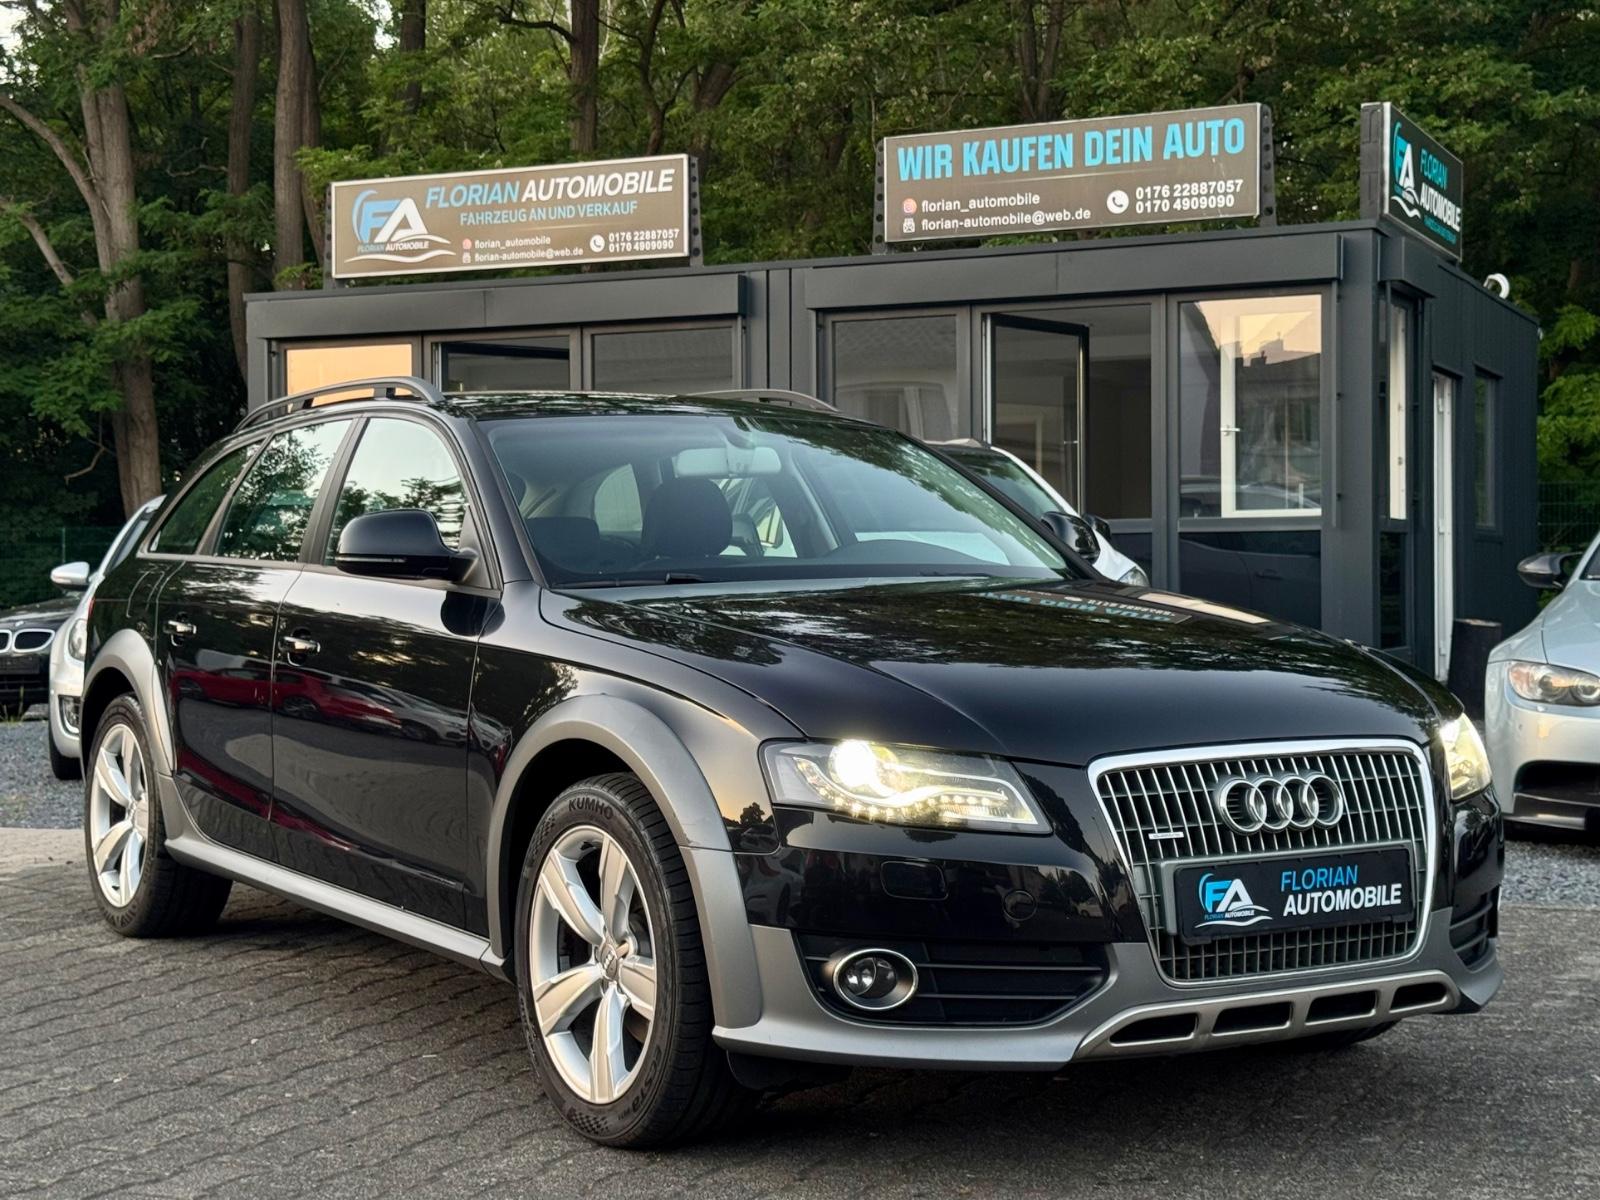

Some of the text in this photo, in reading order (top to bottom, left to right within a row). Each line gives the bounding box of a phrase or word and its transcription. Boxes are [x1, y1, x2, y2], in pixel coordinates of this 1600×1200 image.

[897, 117, 1245, 181] WIR KAUFEN DEIN AUTO
[1420, 147, 1448, 191] FLORIAN
[425, 168, 675, 209] FLORIAN AUTOMOBILE
[1135, 179, 1244, 200] 0176 22887057
[460, 200, 638, 226] FAHRZEUG AN UND VERKAUF
[921, 192, 1041, 213] florian_automobile
[1135, 194, 1235, 214] 0170 4909090
[1420, 182, 1461, 233] AUTOMOBILE
[360, 198, 429, 243] FA
[921, 208, 1092, 231] florian-automobile@web.de
[385, 240, 430, 252] AUTOMOBILE
[474, 236, 551, 250] florian_automobile
[608, 228, 680, 243] 0176 22887057
[608, 239, 675, 253] 0170 4909090
[474, 247, 584, 262] florian-automobile@web.de
[568, 796, 614, 820] KUMHO
[1280, 864, 1358, 893] FLORIAN
[1283, 883, 1402, 917] AUTOMOBILE
